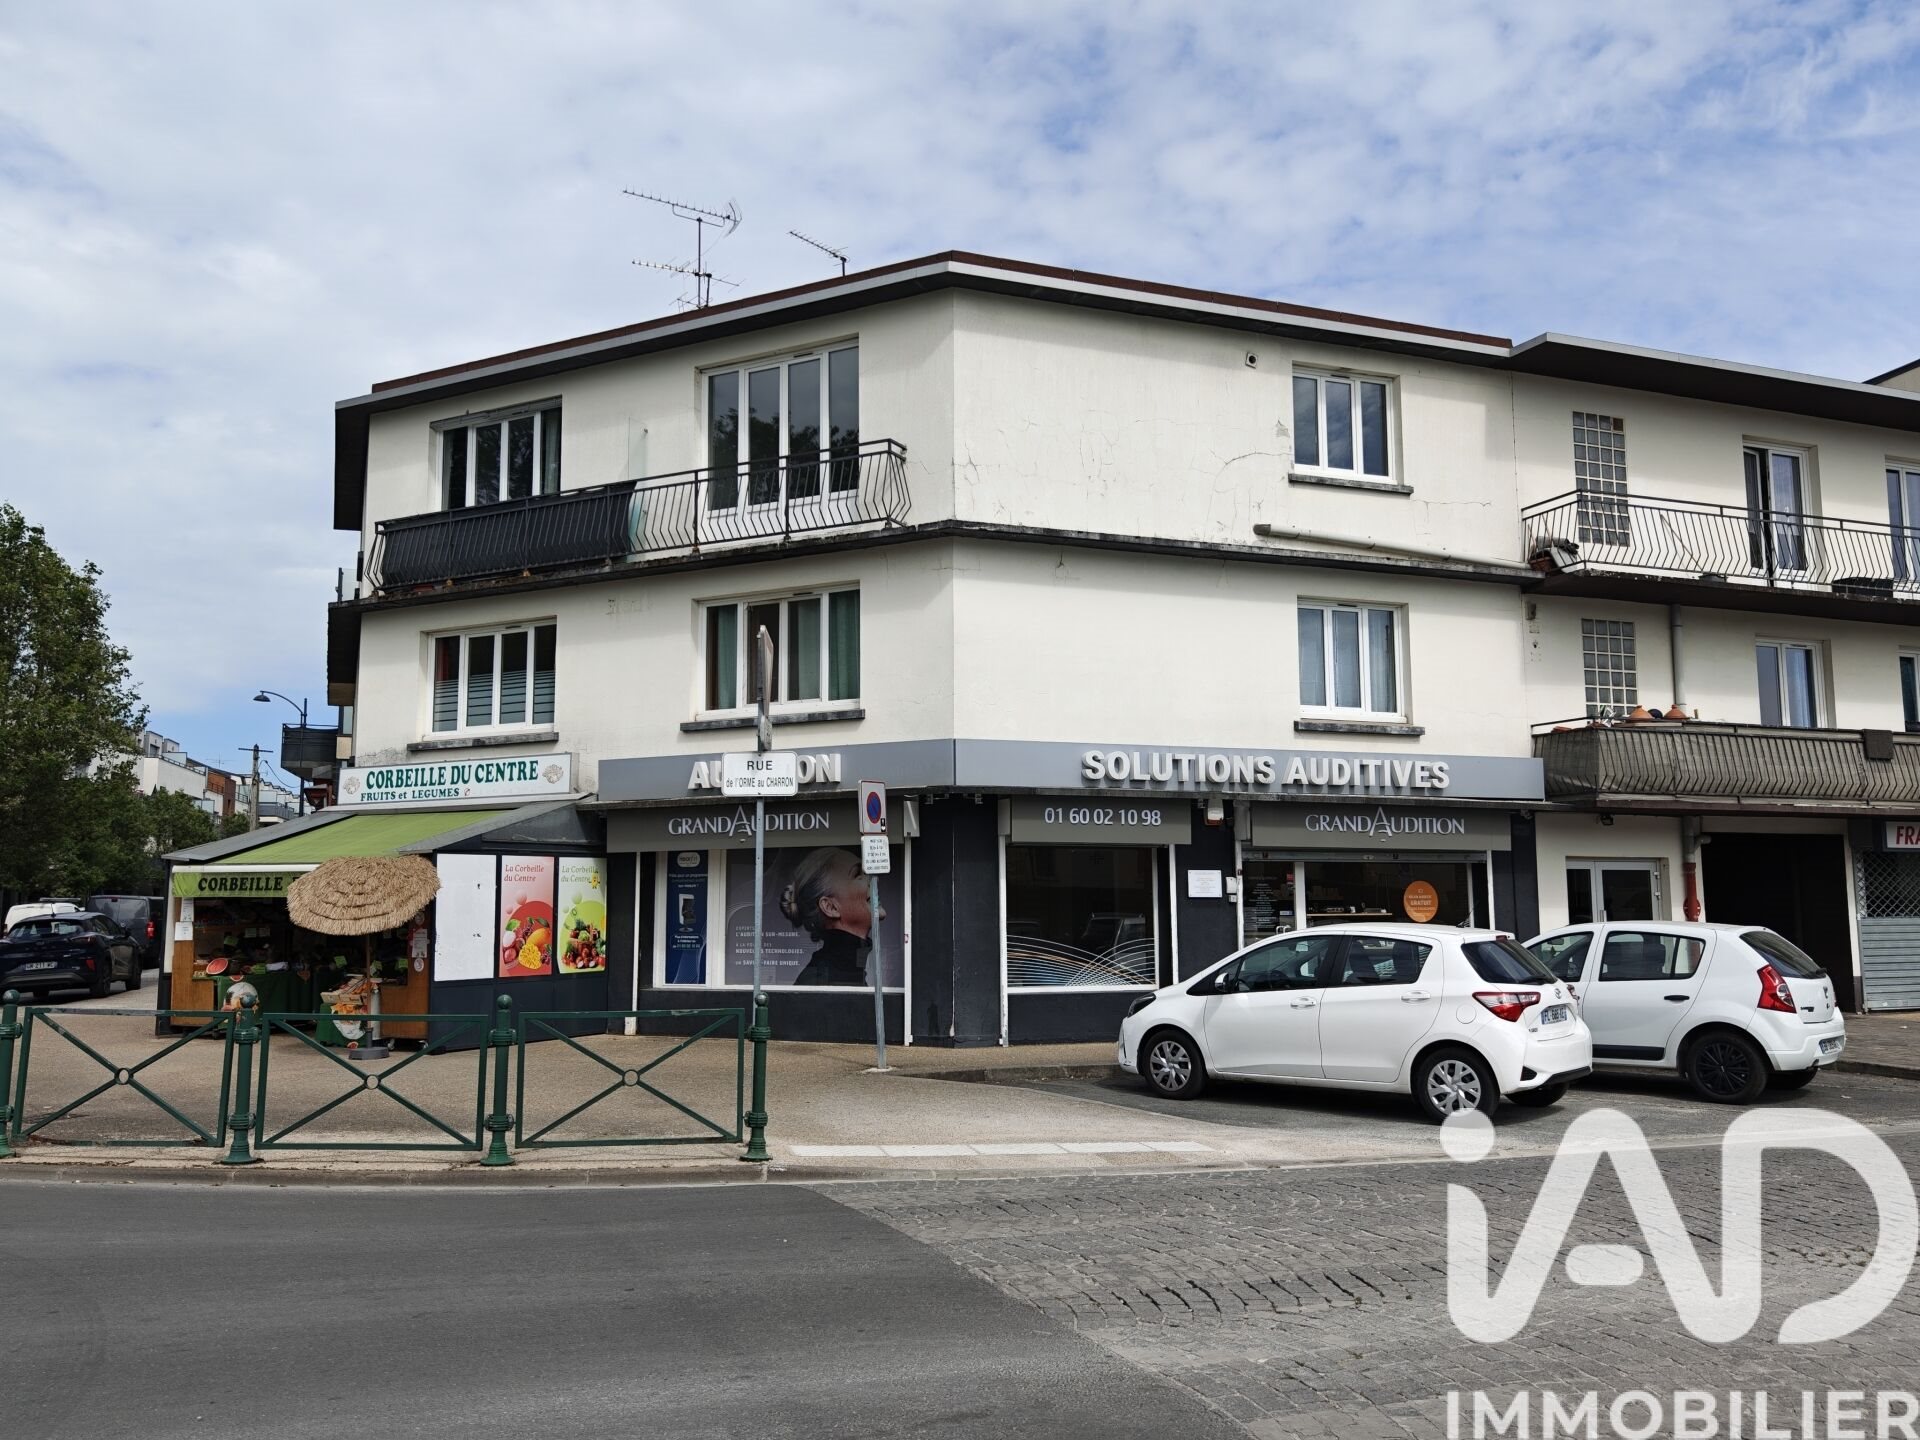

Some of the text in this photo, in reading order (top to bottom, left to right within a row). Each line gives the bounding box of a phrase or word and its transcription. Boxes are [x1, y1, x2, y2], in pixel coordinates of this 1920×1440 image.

[688, 753, 842, 790] AUON
[746, 760, 773, 771] RUE
[1082, 751, 1451, 789] SOLUTIONS AUDITIVES
[366, 760, 539, 789] CORBEILLE DU CENTRE
[726, 776, 794, 788] de l'ORME au CHARRON
[360, 788, 460, 802] FRUITS et LEGUMES
[1044, 807, 1161, 826] 01 60 02 10 98
[505, 864, 545, 873] La Corbeille
[561, 865, 570, 873] La
[197, 876, 284, 892] CORBEILLE
[503, 874, 537, 882] du Centre
